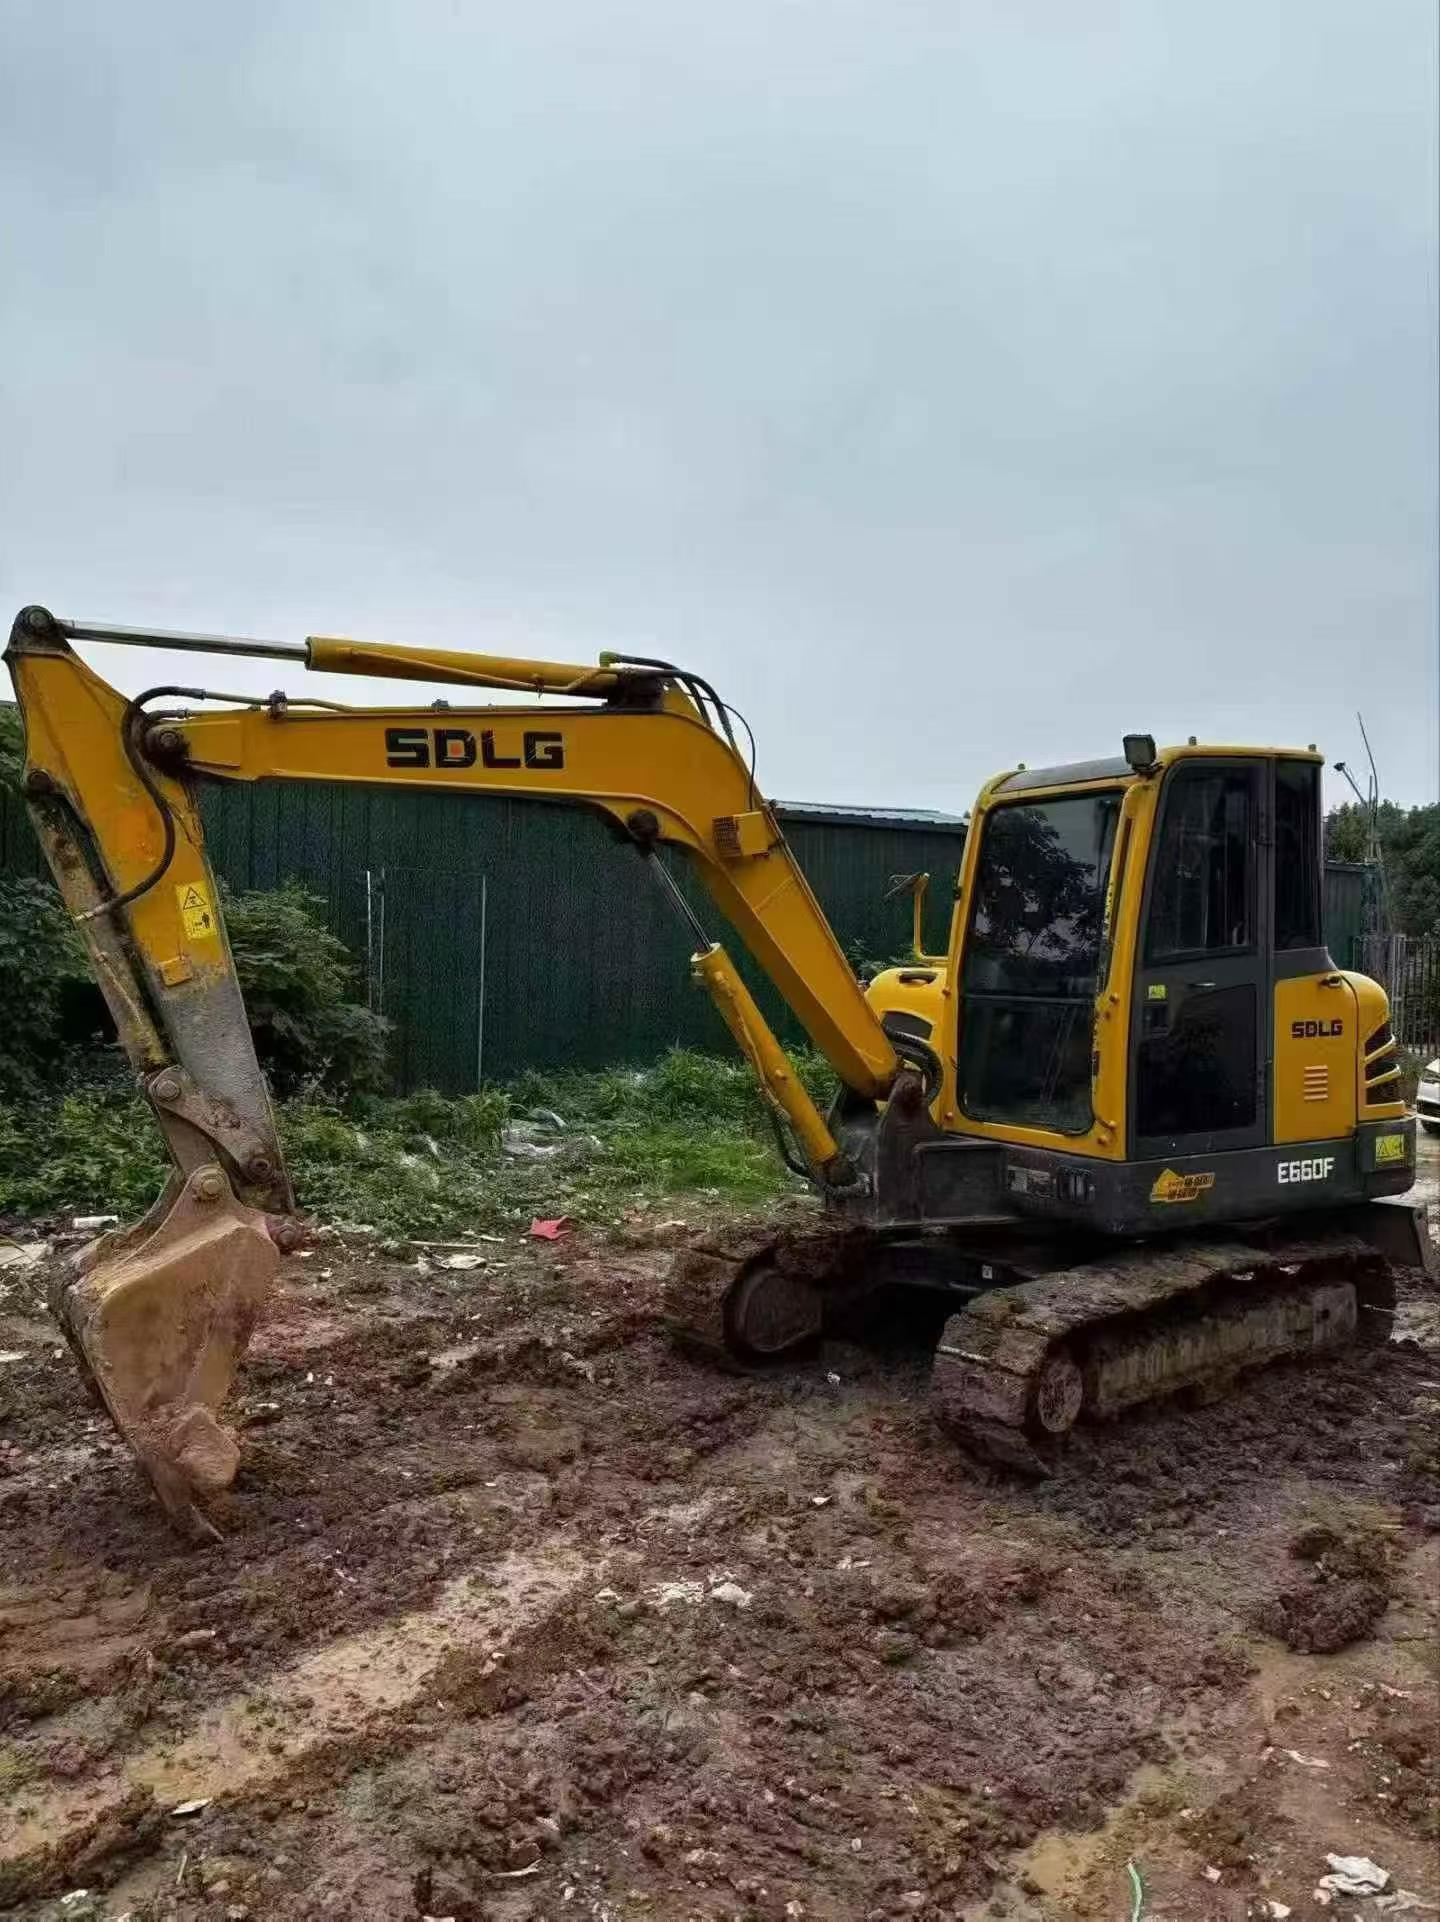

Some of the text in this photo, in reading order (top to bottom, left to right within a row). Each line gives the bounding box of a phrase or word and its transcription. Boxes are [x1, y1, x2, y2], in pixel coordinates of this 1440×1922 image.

[385, 728, 564, 769] SDLG
[1291, 1019, 1343, 1038] SDLG
[1277, 1157, 1335, 1184] E660F
